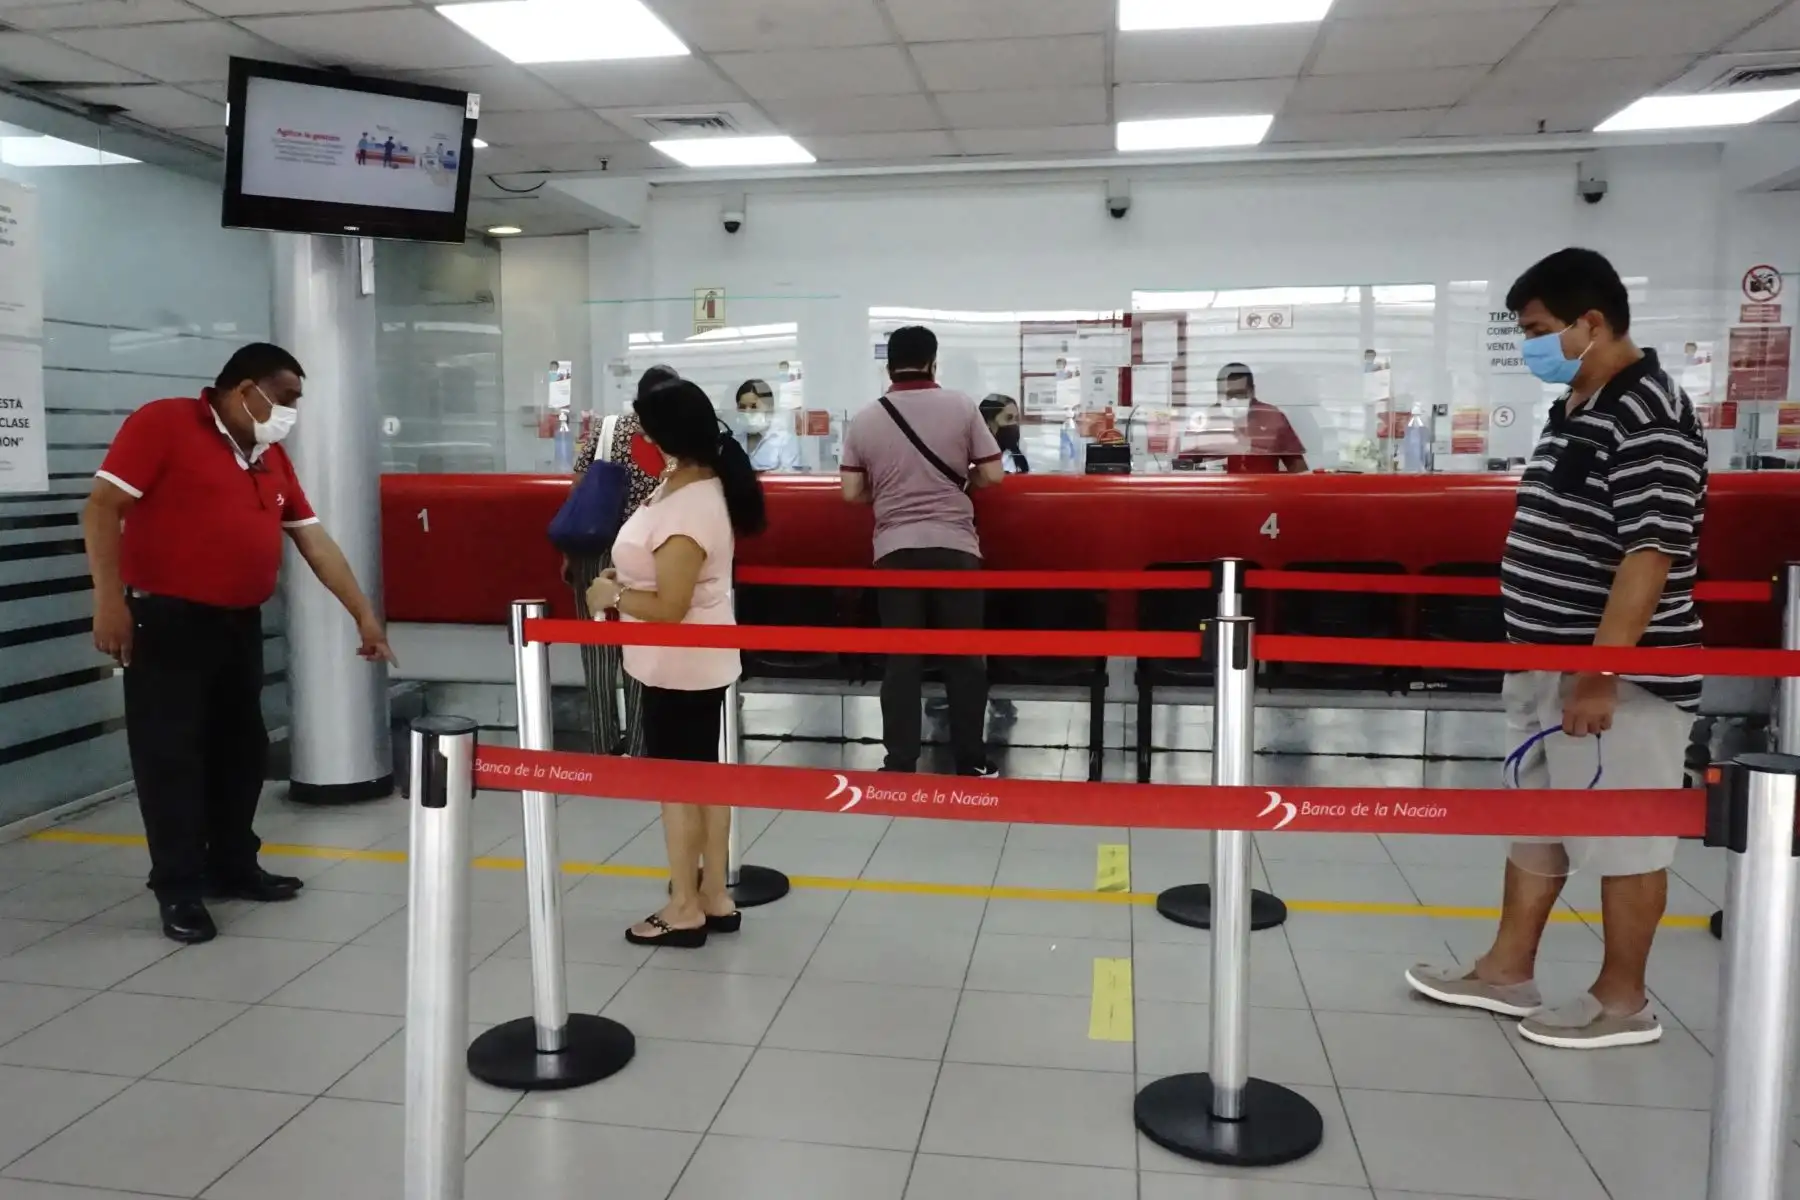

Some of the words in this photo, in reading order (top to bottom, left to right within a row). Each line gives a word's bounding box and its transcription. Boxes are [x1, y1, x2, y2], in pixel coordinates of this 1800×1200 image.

[1488, 311, 1517, 321] TIPO
[1486, 342, 1516, 351] VENTA
[0, 417, 31, 428] CLASE
[1499, 411, 1508, 423] 5
[417, 508, 430, 532] 1
[1260, 512, 1280, 539] 4
[475, 758, 511, 775] Banco
[515, 762, 530, 777] de
[534, 764, 545, 778] la
[549, 766, 593, 782] Nación
[866, 785, 906, 801] Banco
[912, 788, 928, 803] de
[933, 789, 945, 803] la
[950, 790, 999, 806] Nación
[1301, 801, 1345, 816] Banco
[1351, 802, 1369, 816] de
[1375, 802, 1387, 816] la
[1394, 802, 1447, 818] Nación
